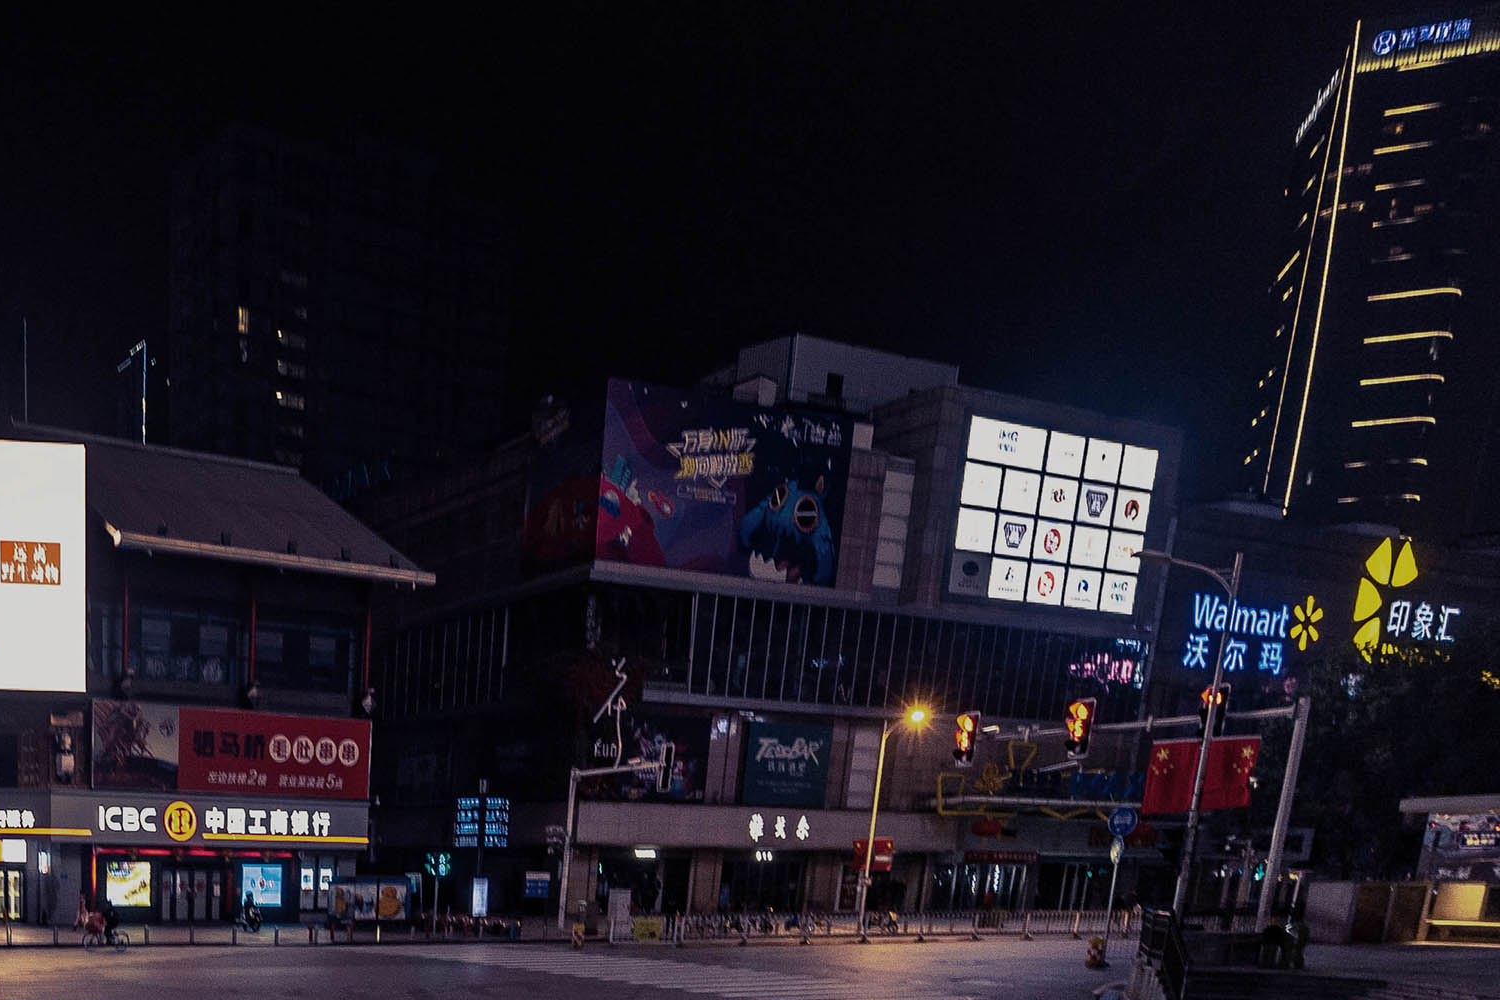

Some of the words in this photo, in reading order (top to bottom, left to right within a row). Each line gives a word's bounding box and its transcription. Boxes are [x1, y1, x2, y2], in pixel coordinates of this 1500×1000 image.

[1191, 592, 1291, 638] Walmart
[1385, 599, 1462, 642] 印象汇
[1182, 632, 1285, 675] 沃尔玛
[97, 805, 157, 833] ICBC
[204, 806, 331, 837] 中国工商银行
